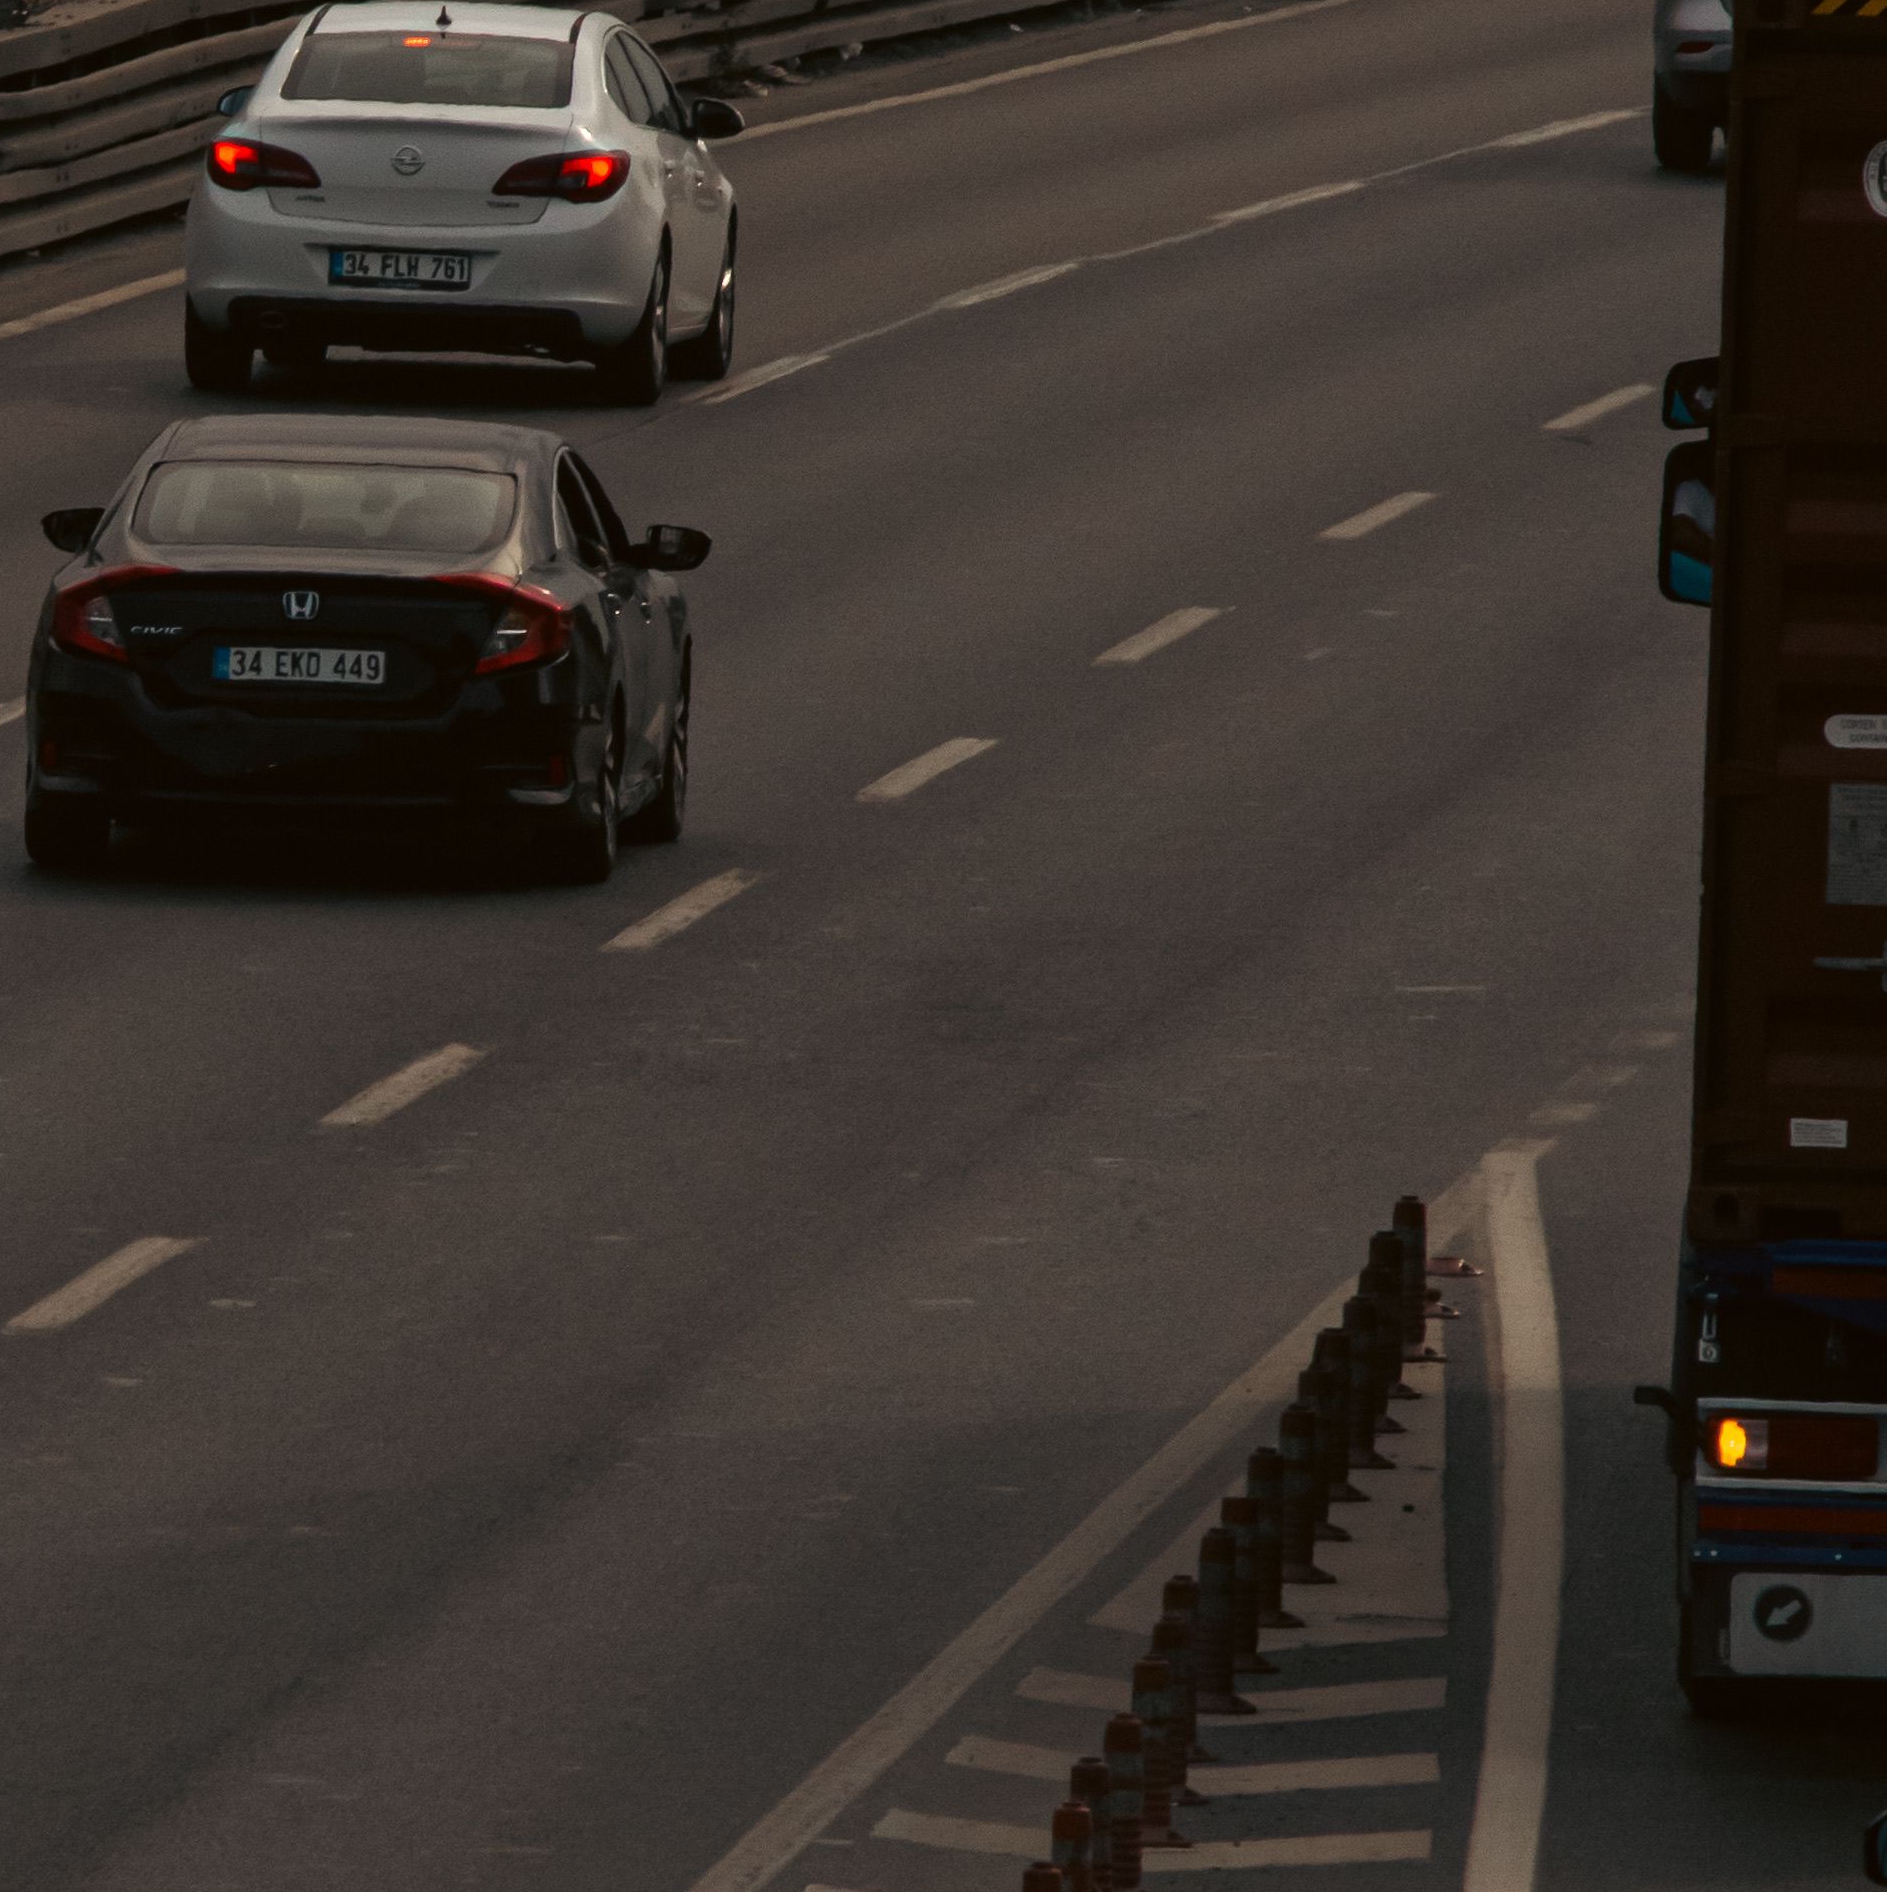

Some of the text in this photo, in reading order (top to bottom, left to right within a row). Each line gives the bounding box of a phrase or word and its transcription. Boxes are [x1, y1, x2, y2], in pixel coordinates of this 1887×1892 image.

[344, 252, 370, 275] 34
[431, 257, 466, 280] 761
[129, 625, 183, 635] CIVIC
[231, 650, 263, 676] 34
[332, 653, 382, 681] 449
